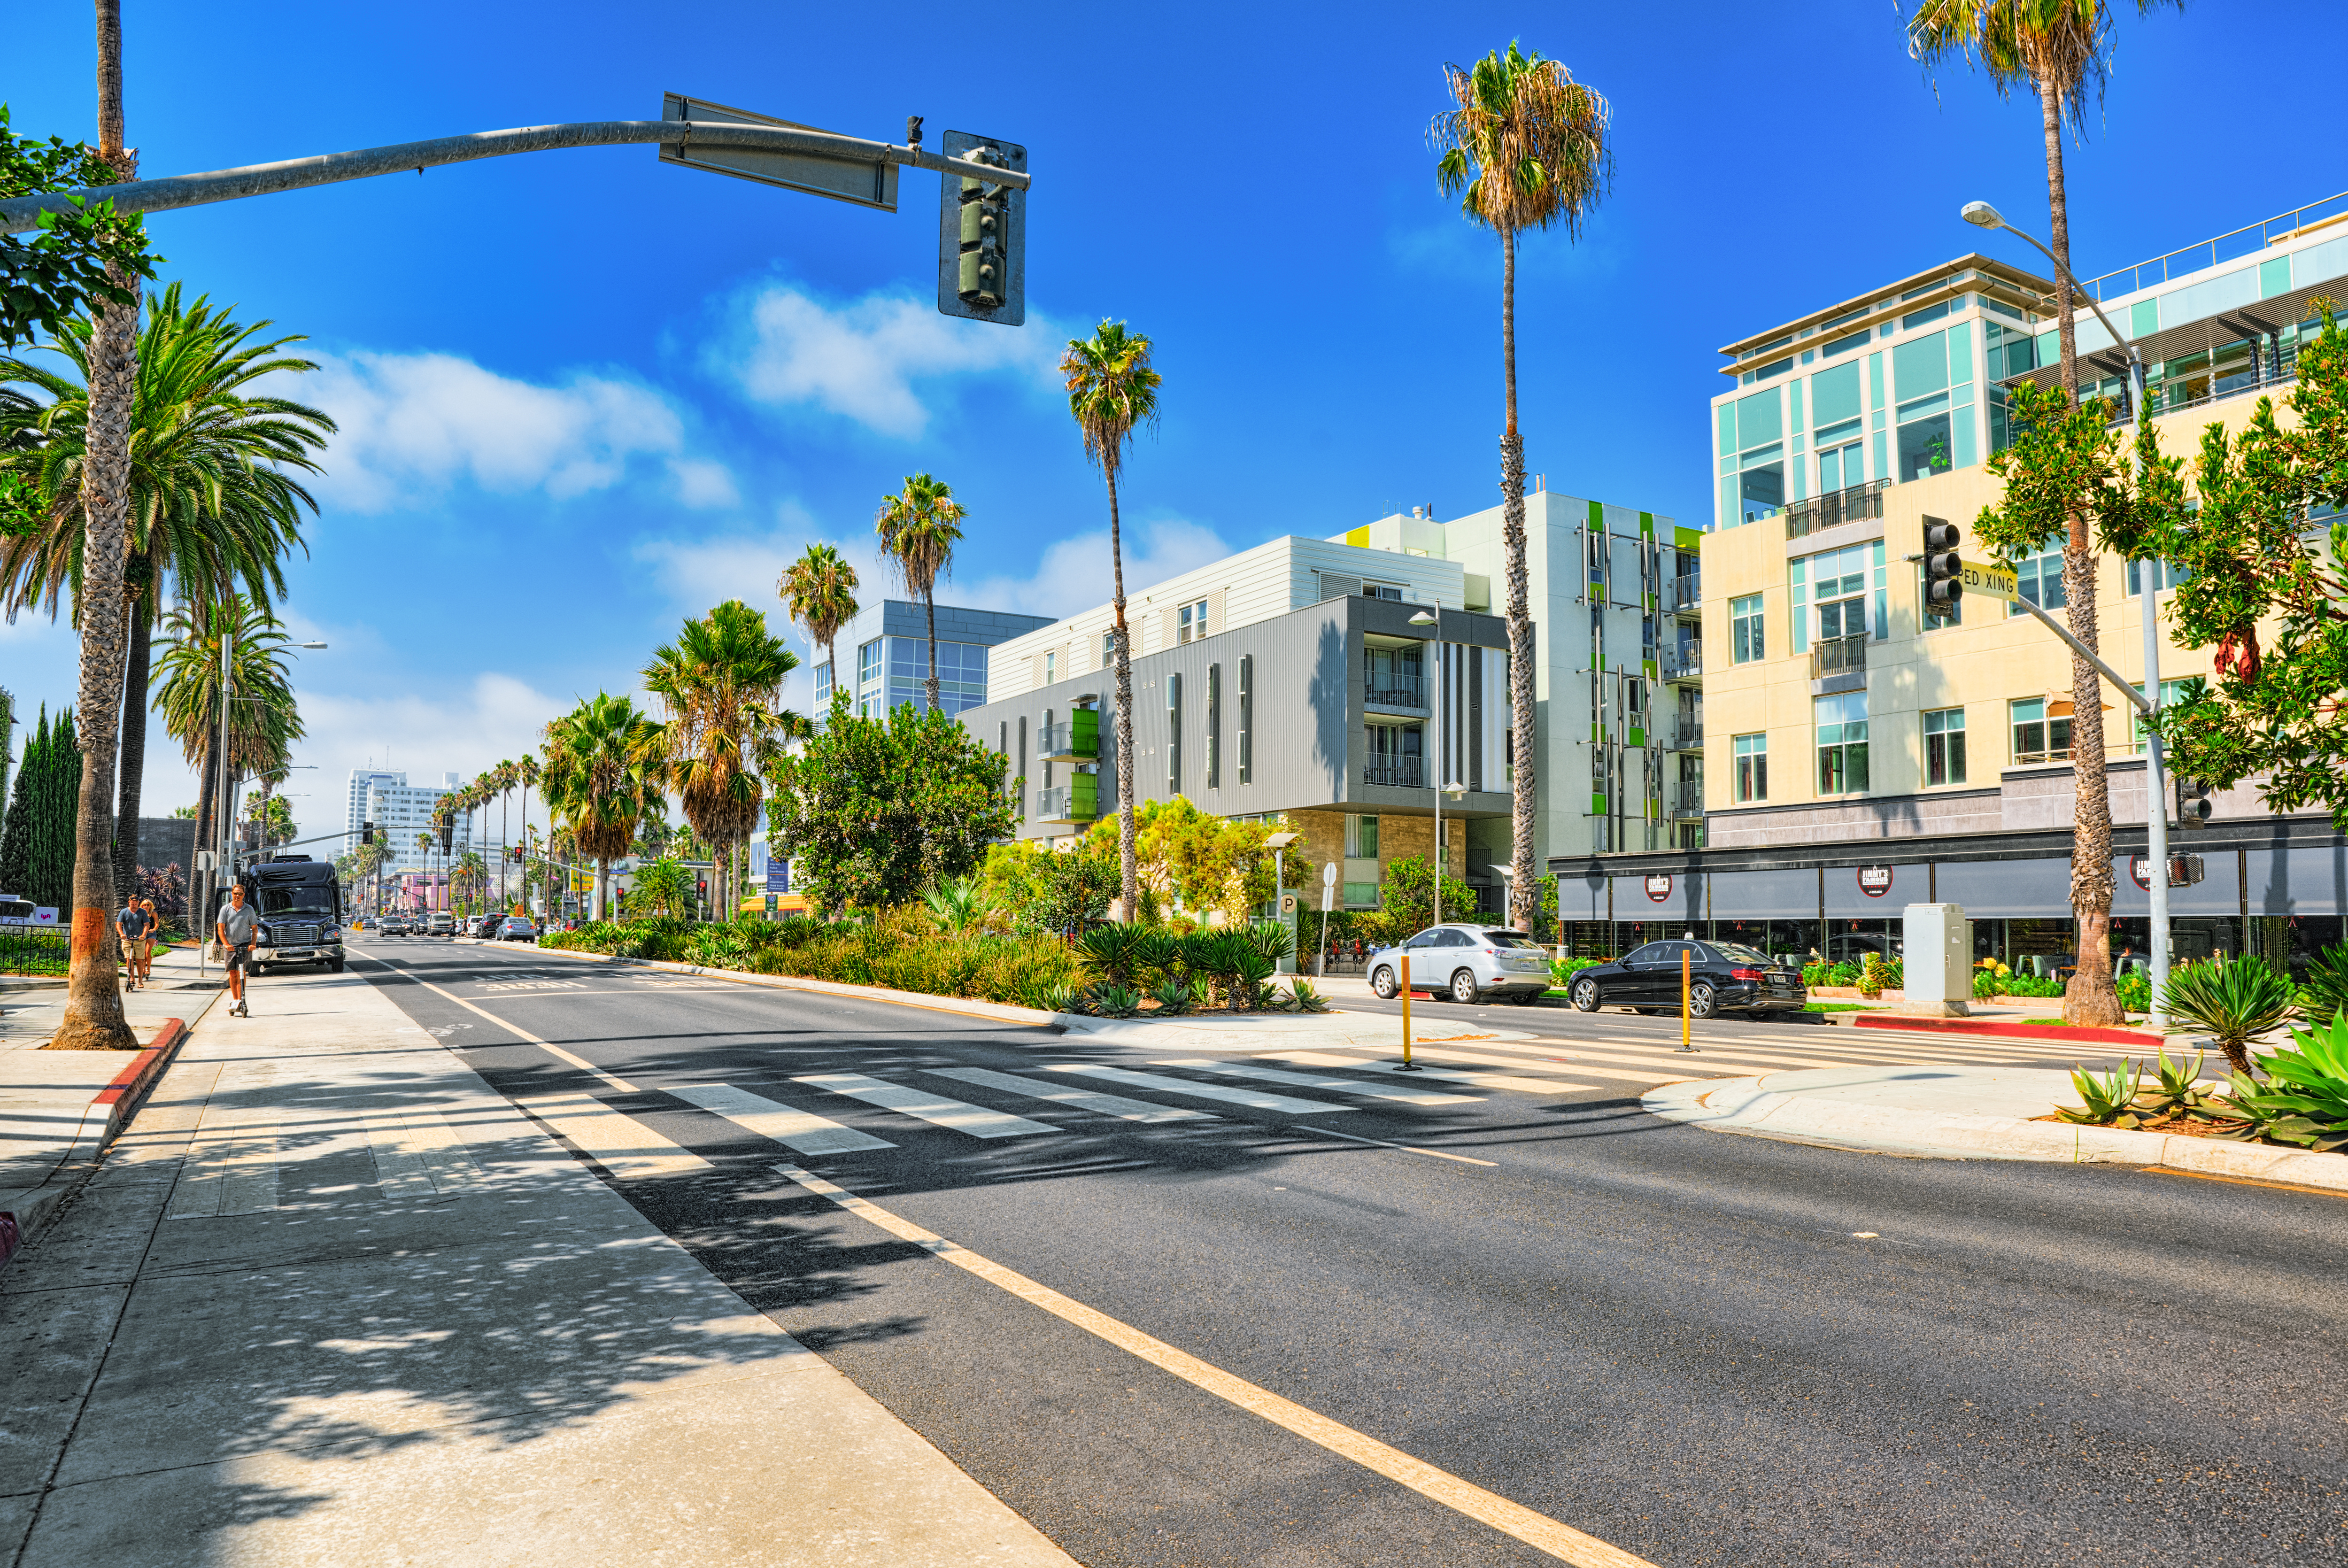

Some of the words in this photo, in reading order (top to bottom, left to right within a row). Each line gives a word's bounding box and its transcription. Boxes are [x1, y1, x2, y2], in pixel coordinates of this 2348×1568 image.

[1986, 573, 2013, 593] XING
[2136, 860, 2171, 869] JIMS
[1285, 898, 1293, 910] P
[475, 981, 588, 991] HERE
